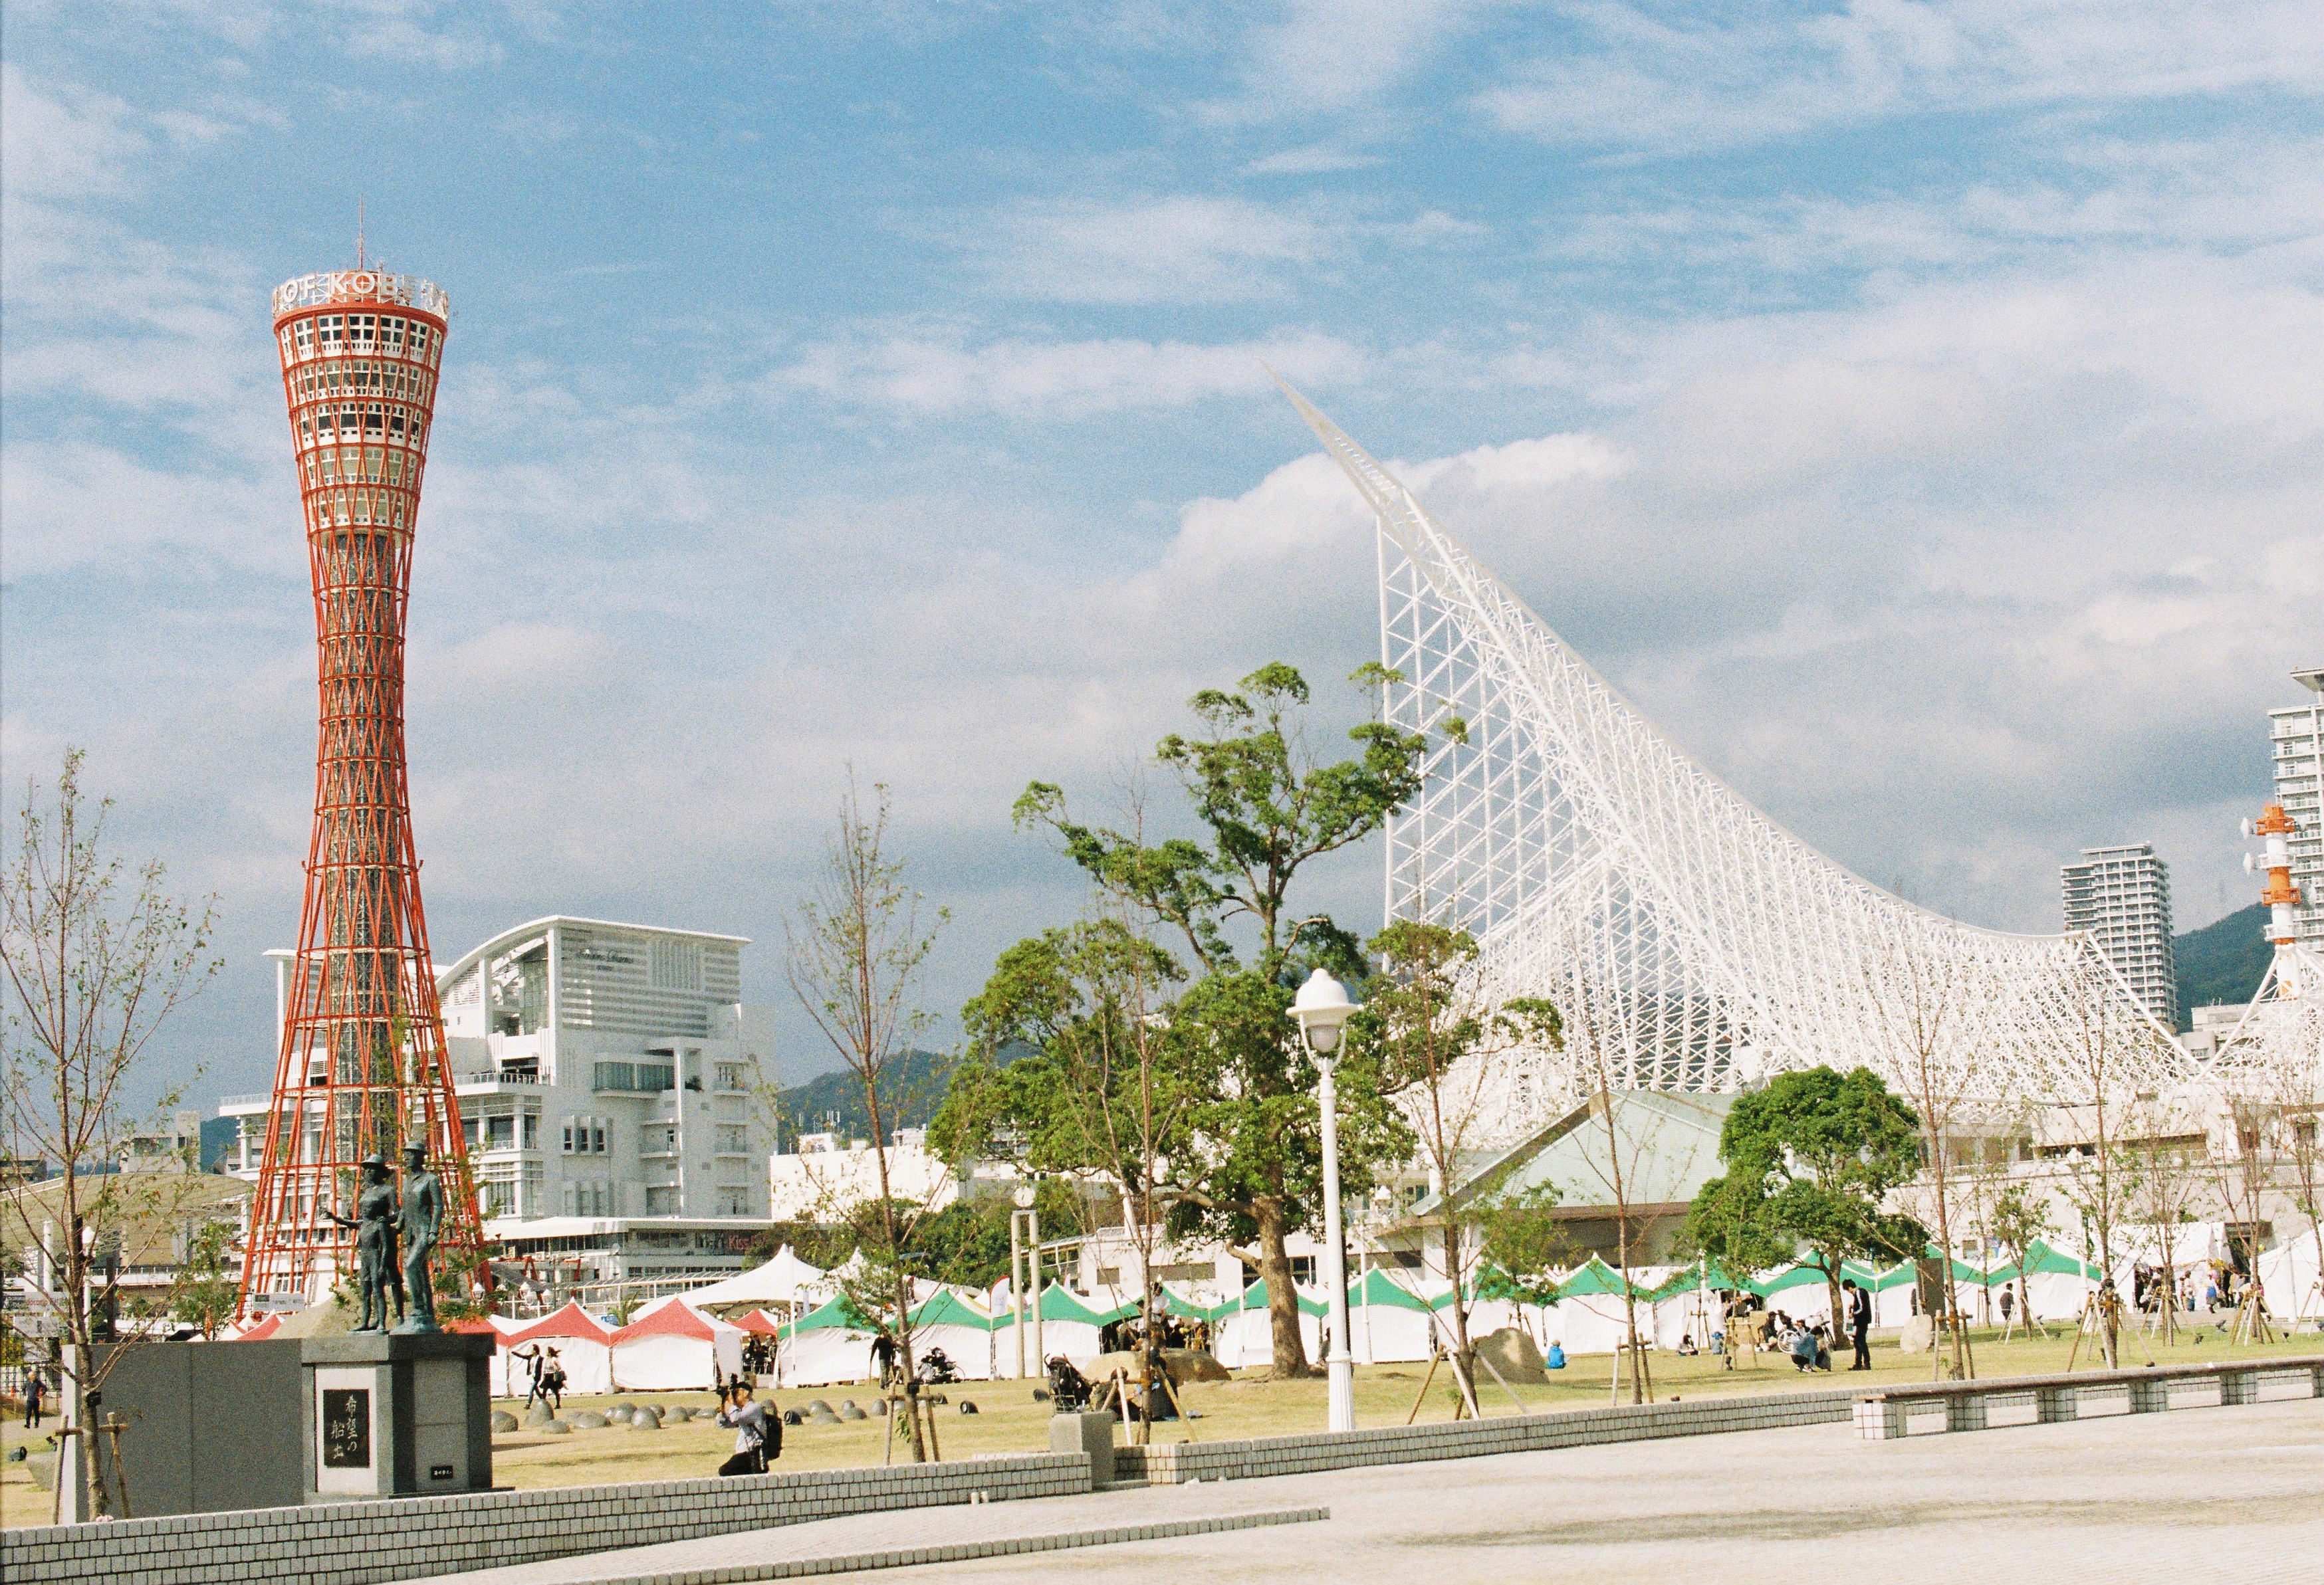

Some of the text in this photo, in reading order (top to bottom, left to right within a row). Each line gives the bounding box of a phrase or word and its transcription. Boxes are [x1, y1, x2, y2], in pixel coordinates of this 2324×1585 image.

[283, 274, 316, 303] OF
[330, 270, 416, 298] KOBE
[331, 1419, 344, 1459] 船出
[345, 1394, 358, 1452] 希望の
